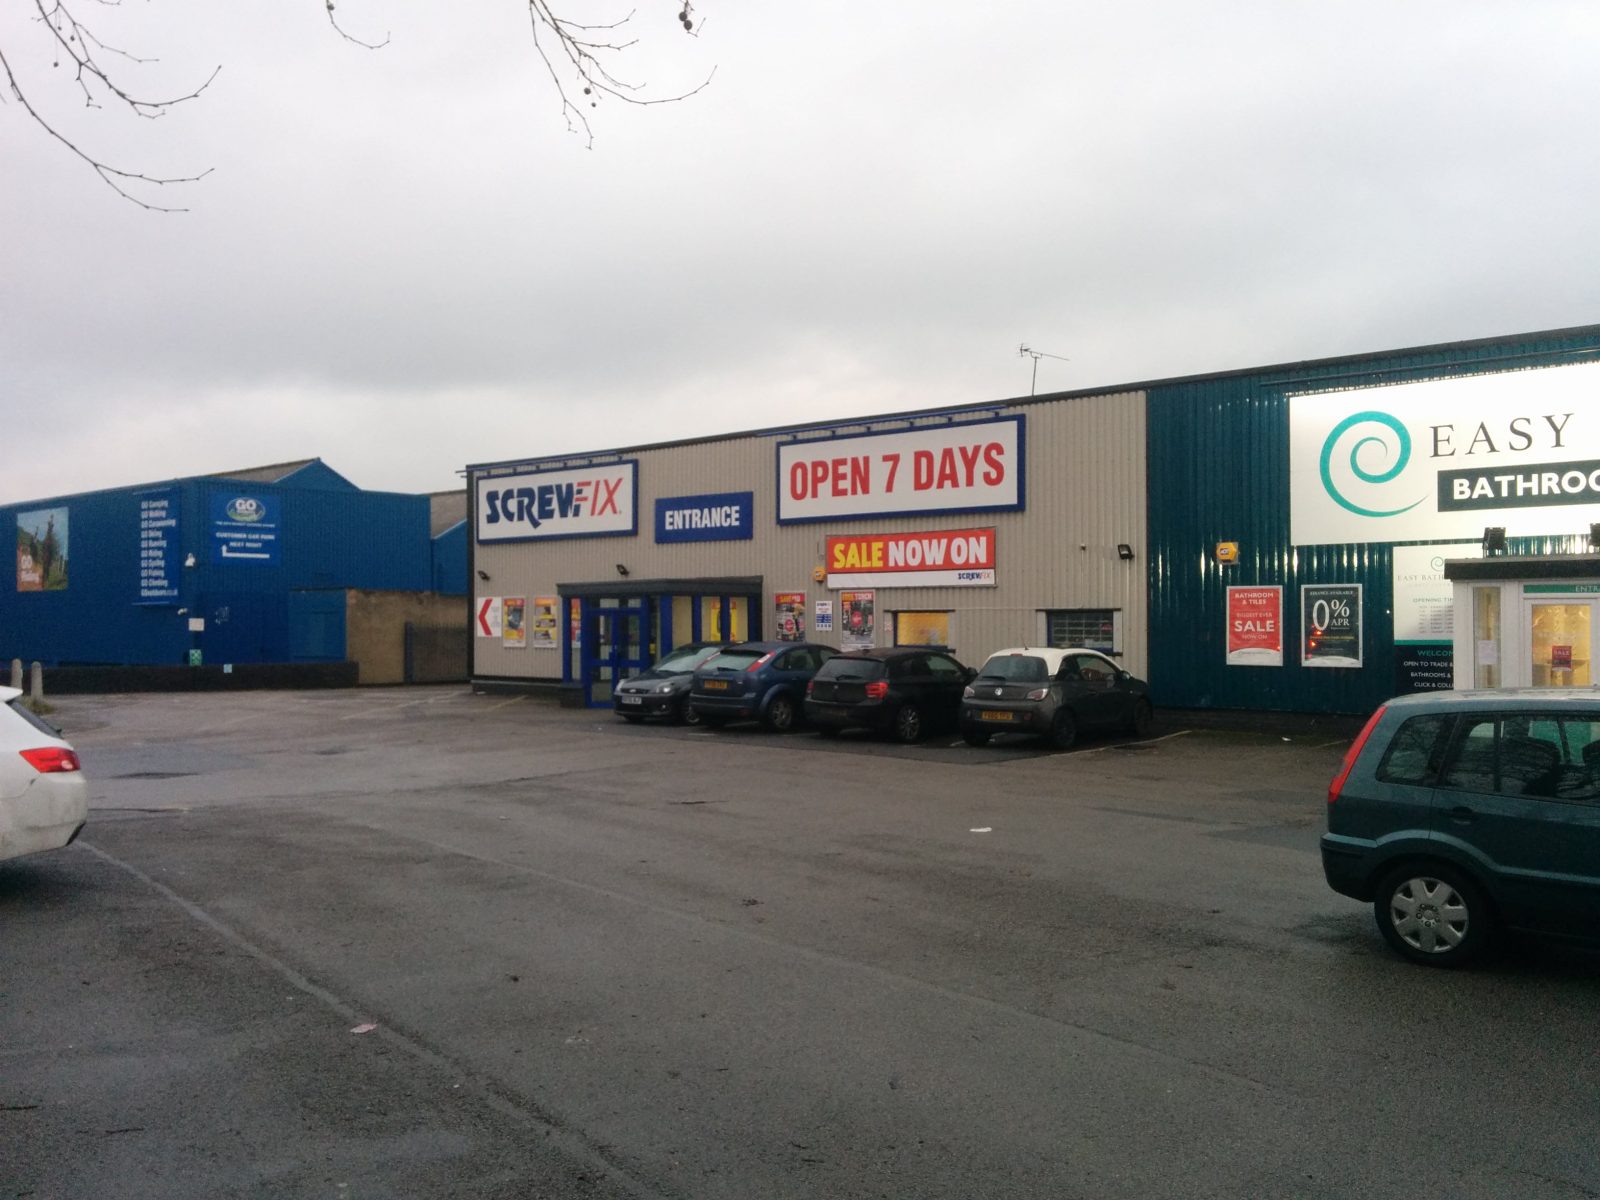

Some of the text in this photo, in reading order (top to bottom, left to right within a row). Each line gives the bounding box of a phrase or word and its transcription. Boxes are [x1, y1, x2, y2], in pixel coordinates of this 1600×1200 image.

[1429, 413, 1574, 458] EASY
[790, 442, 1005, 500] OPEN 7 DAYS
[235, 500, 257, 510] GO
[486, 477, 623, 529] SCREWFIX
[665, 506, 740, 530] ENTRANCE
[833, 536, 987, 568] SALE NOW ON
[1234, 620, 1275, 632] SALE
